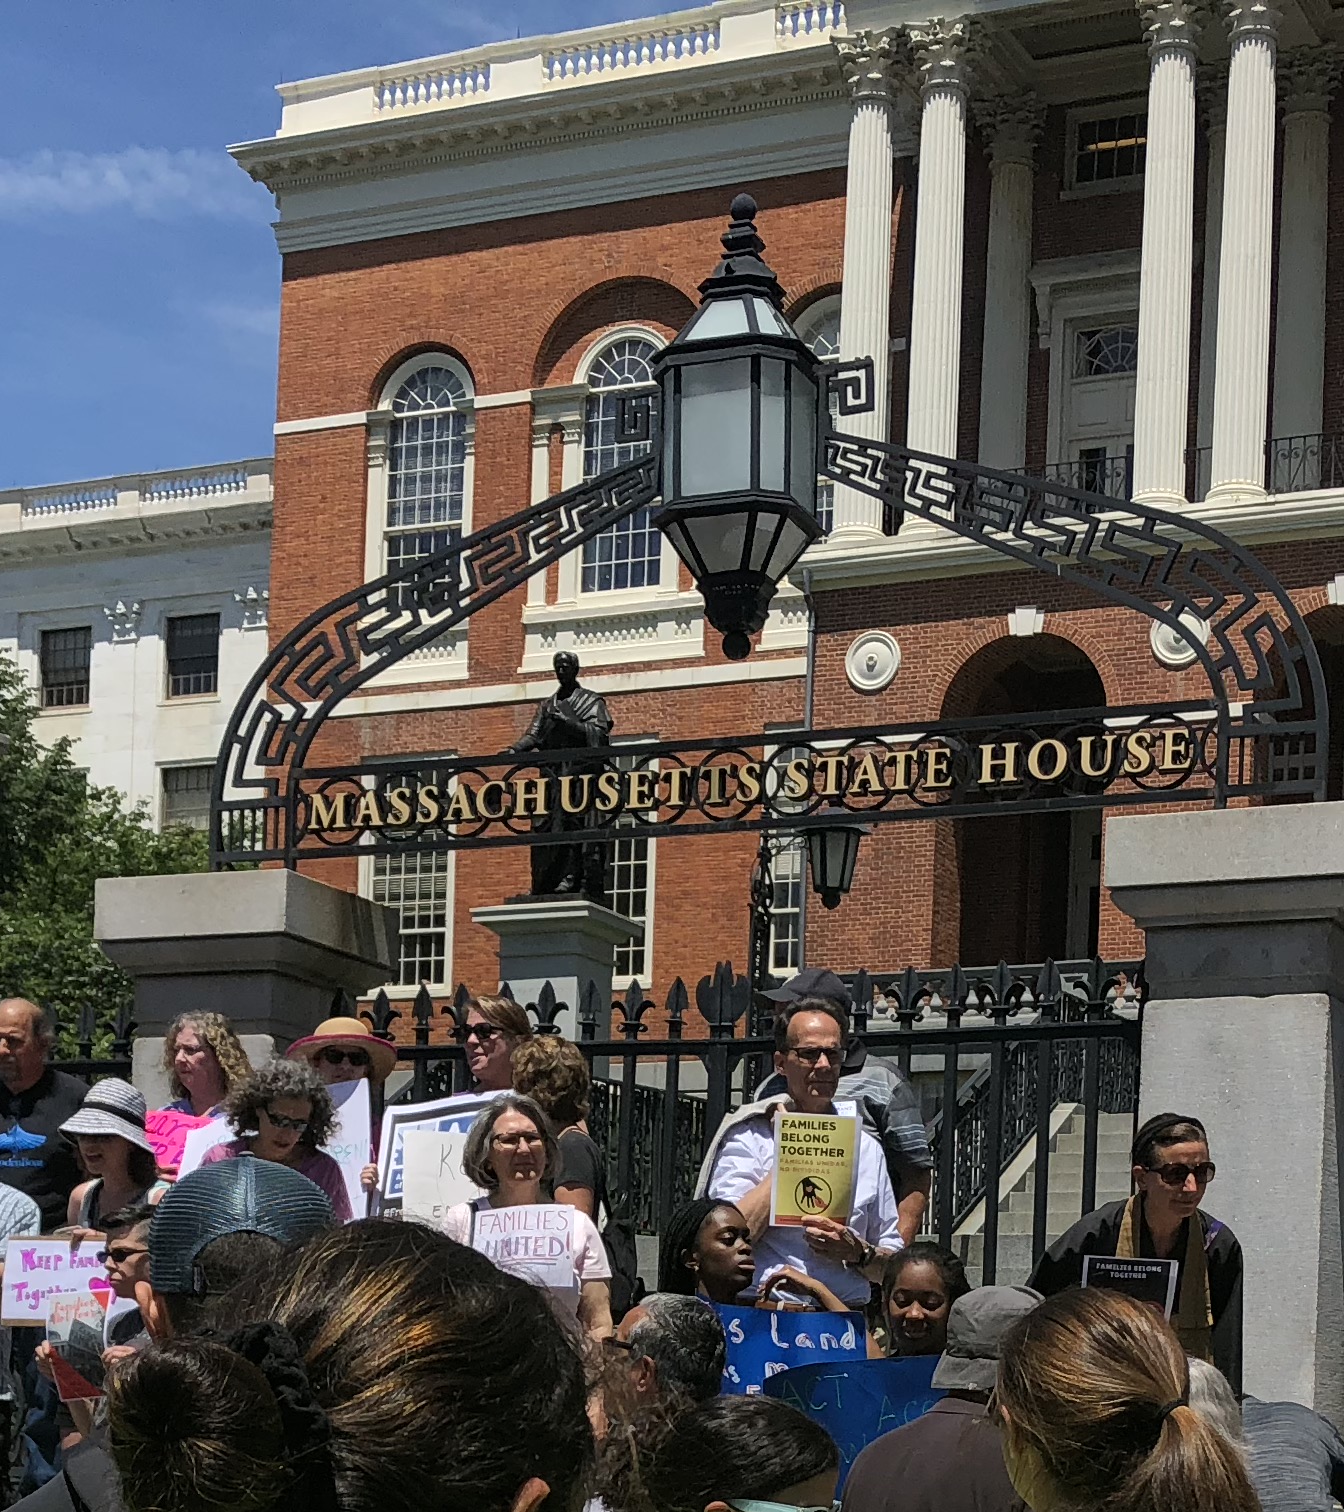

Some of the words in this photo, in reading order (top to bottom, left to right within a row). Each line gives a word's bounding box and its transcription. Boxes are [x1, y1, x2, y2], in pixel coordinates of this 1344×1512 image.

[307, 762, 764, 832] MASSACHUSETTS
[783, 747, 954, 800] STATE
[977, 728, 1194, 785] HOUSE
[781, 1119, 837, 1131] FAMILIES
[780, 1132, 830, 1144] BELONG
[780, 1145, 845, 1158] TOGETHER
[478, 1210, 569, 1235] FAMILIES
[484, 1230, 571, 1260] UNITED!
[770, 1312, 857, 1351] Land
